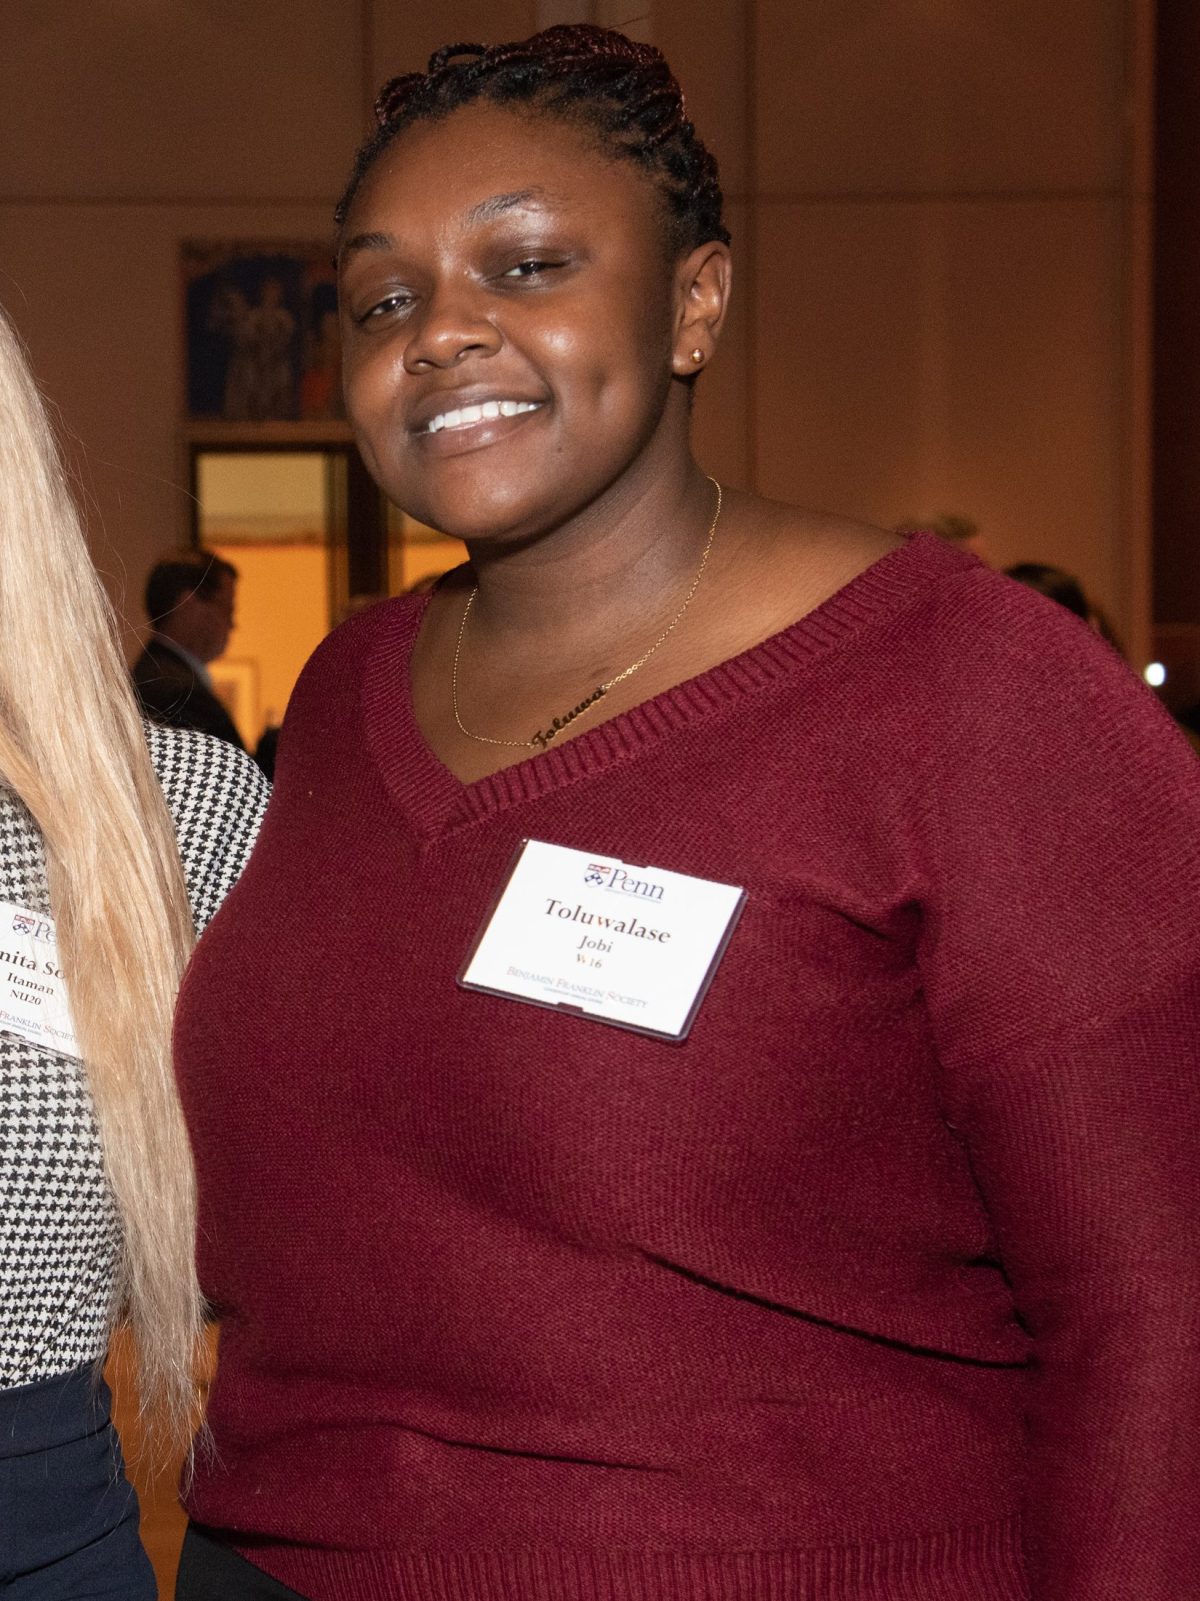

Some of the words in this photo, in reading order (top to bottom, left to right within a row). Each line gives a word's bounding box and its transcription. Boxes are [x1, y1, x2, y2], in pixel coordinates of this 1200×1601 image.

[608, 868, 665, 900] Penn
[545, 899, 672, 944] Toluwalase
[577, 935, 614, 953] Jobi
[7, 972, 55, 996] Itaman
